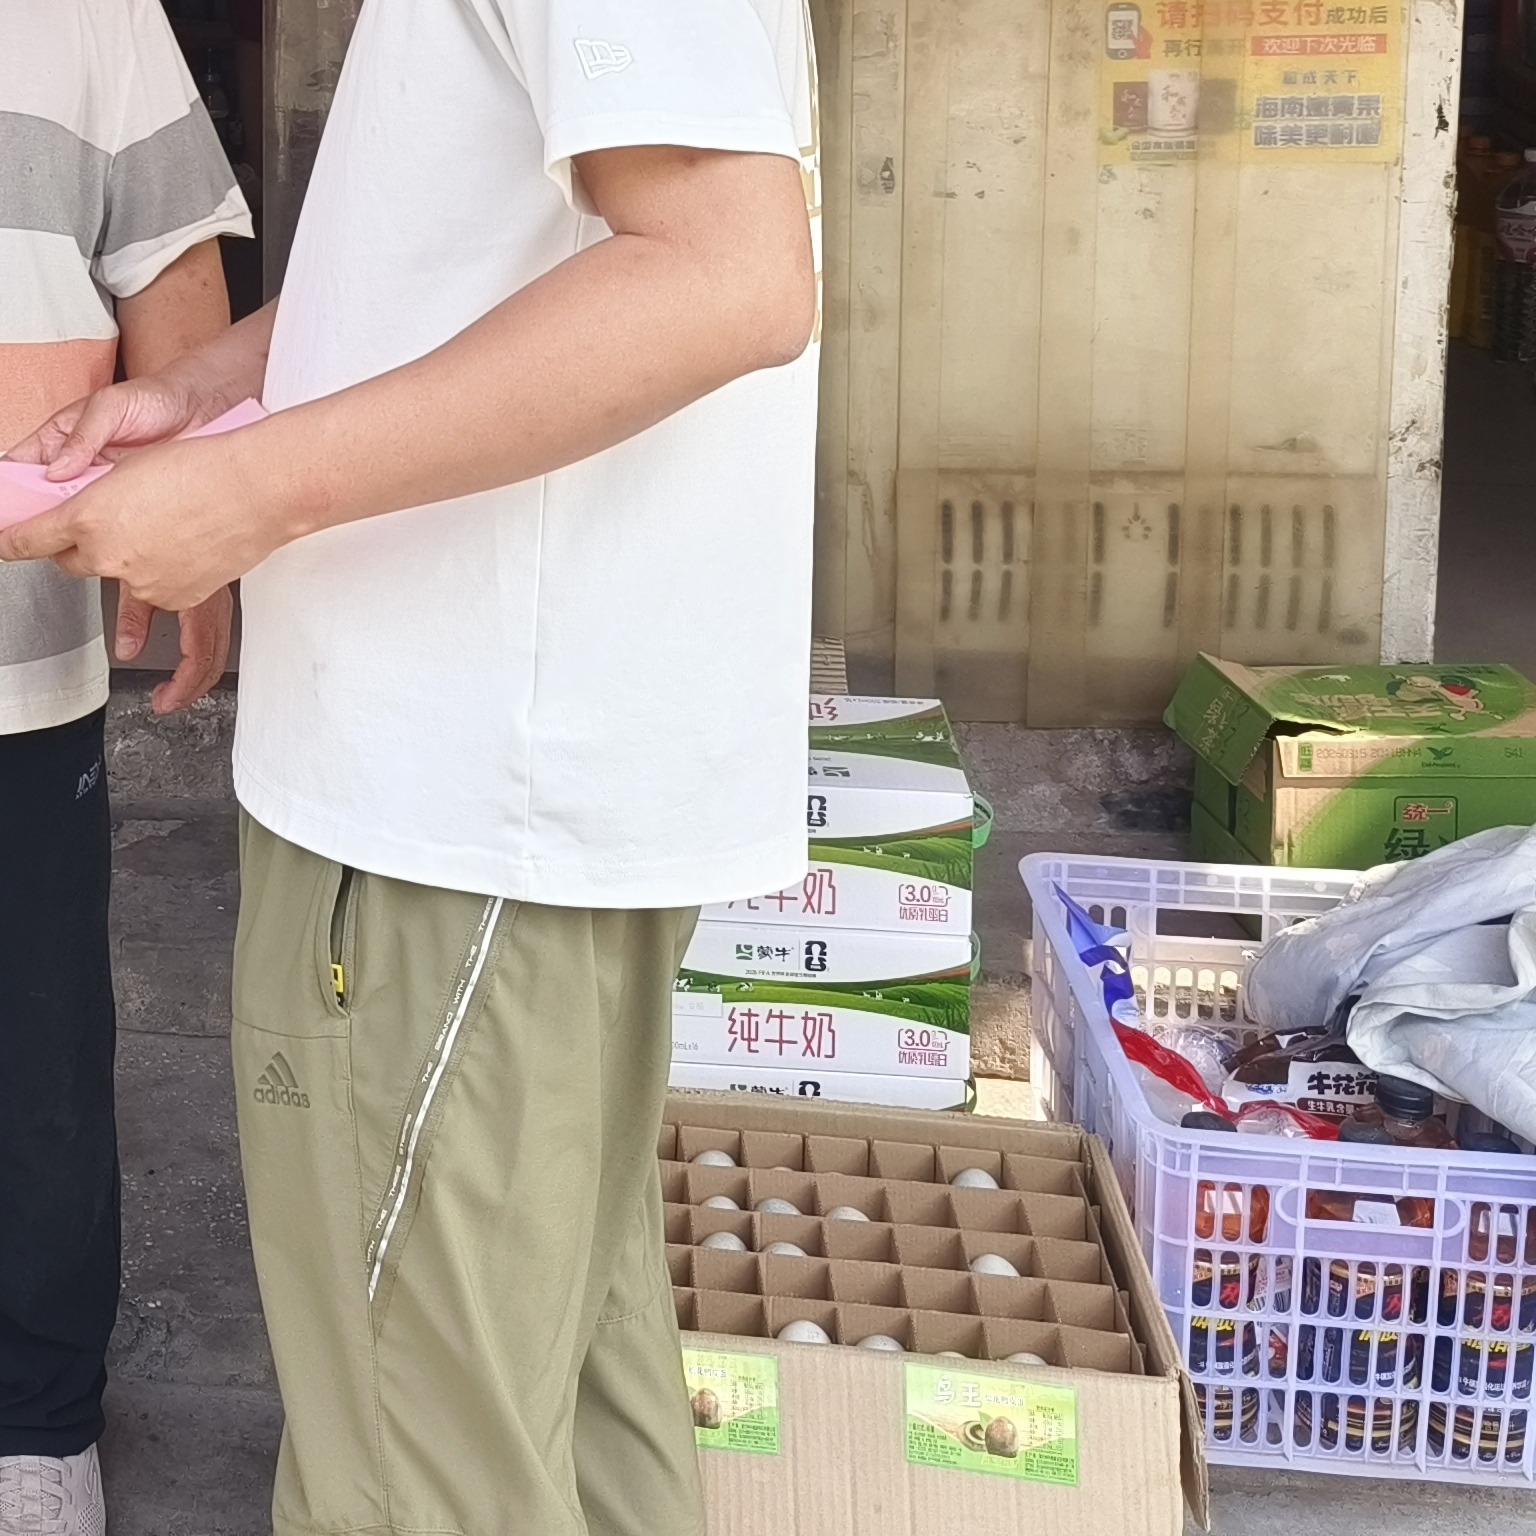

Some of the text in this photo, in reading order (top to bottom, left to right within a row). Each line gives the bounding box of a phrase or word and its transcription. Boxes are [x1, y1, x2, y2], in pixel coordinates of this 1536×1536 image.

[1324, 5, 1389, 25] 成功后
[1263, 35, 1377, 54] 欢迎下次光临
[1402, 800, 1454, 822] 统一
[904, 884, 932, 903] 3.0
[756, 945, 791, 962] 蒙牛
[420, 1061, 434, 1084] THE
[434, 1011, 454, 1052] BRAND
[452, 979, 466, 1005] WITH
[465, 944, 478, 968] THE
[727, 1006, 836, 1059] 纯牛奶
[904, 1028, 931, 1047] 3.0
[253, 1083, 311, 1110] adidas
